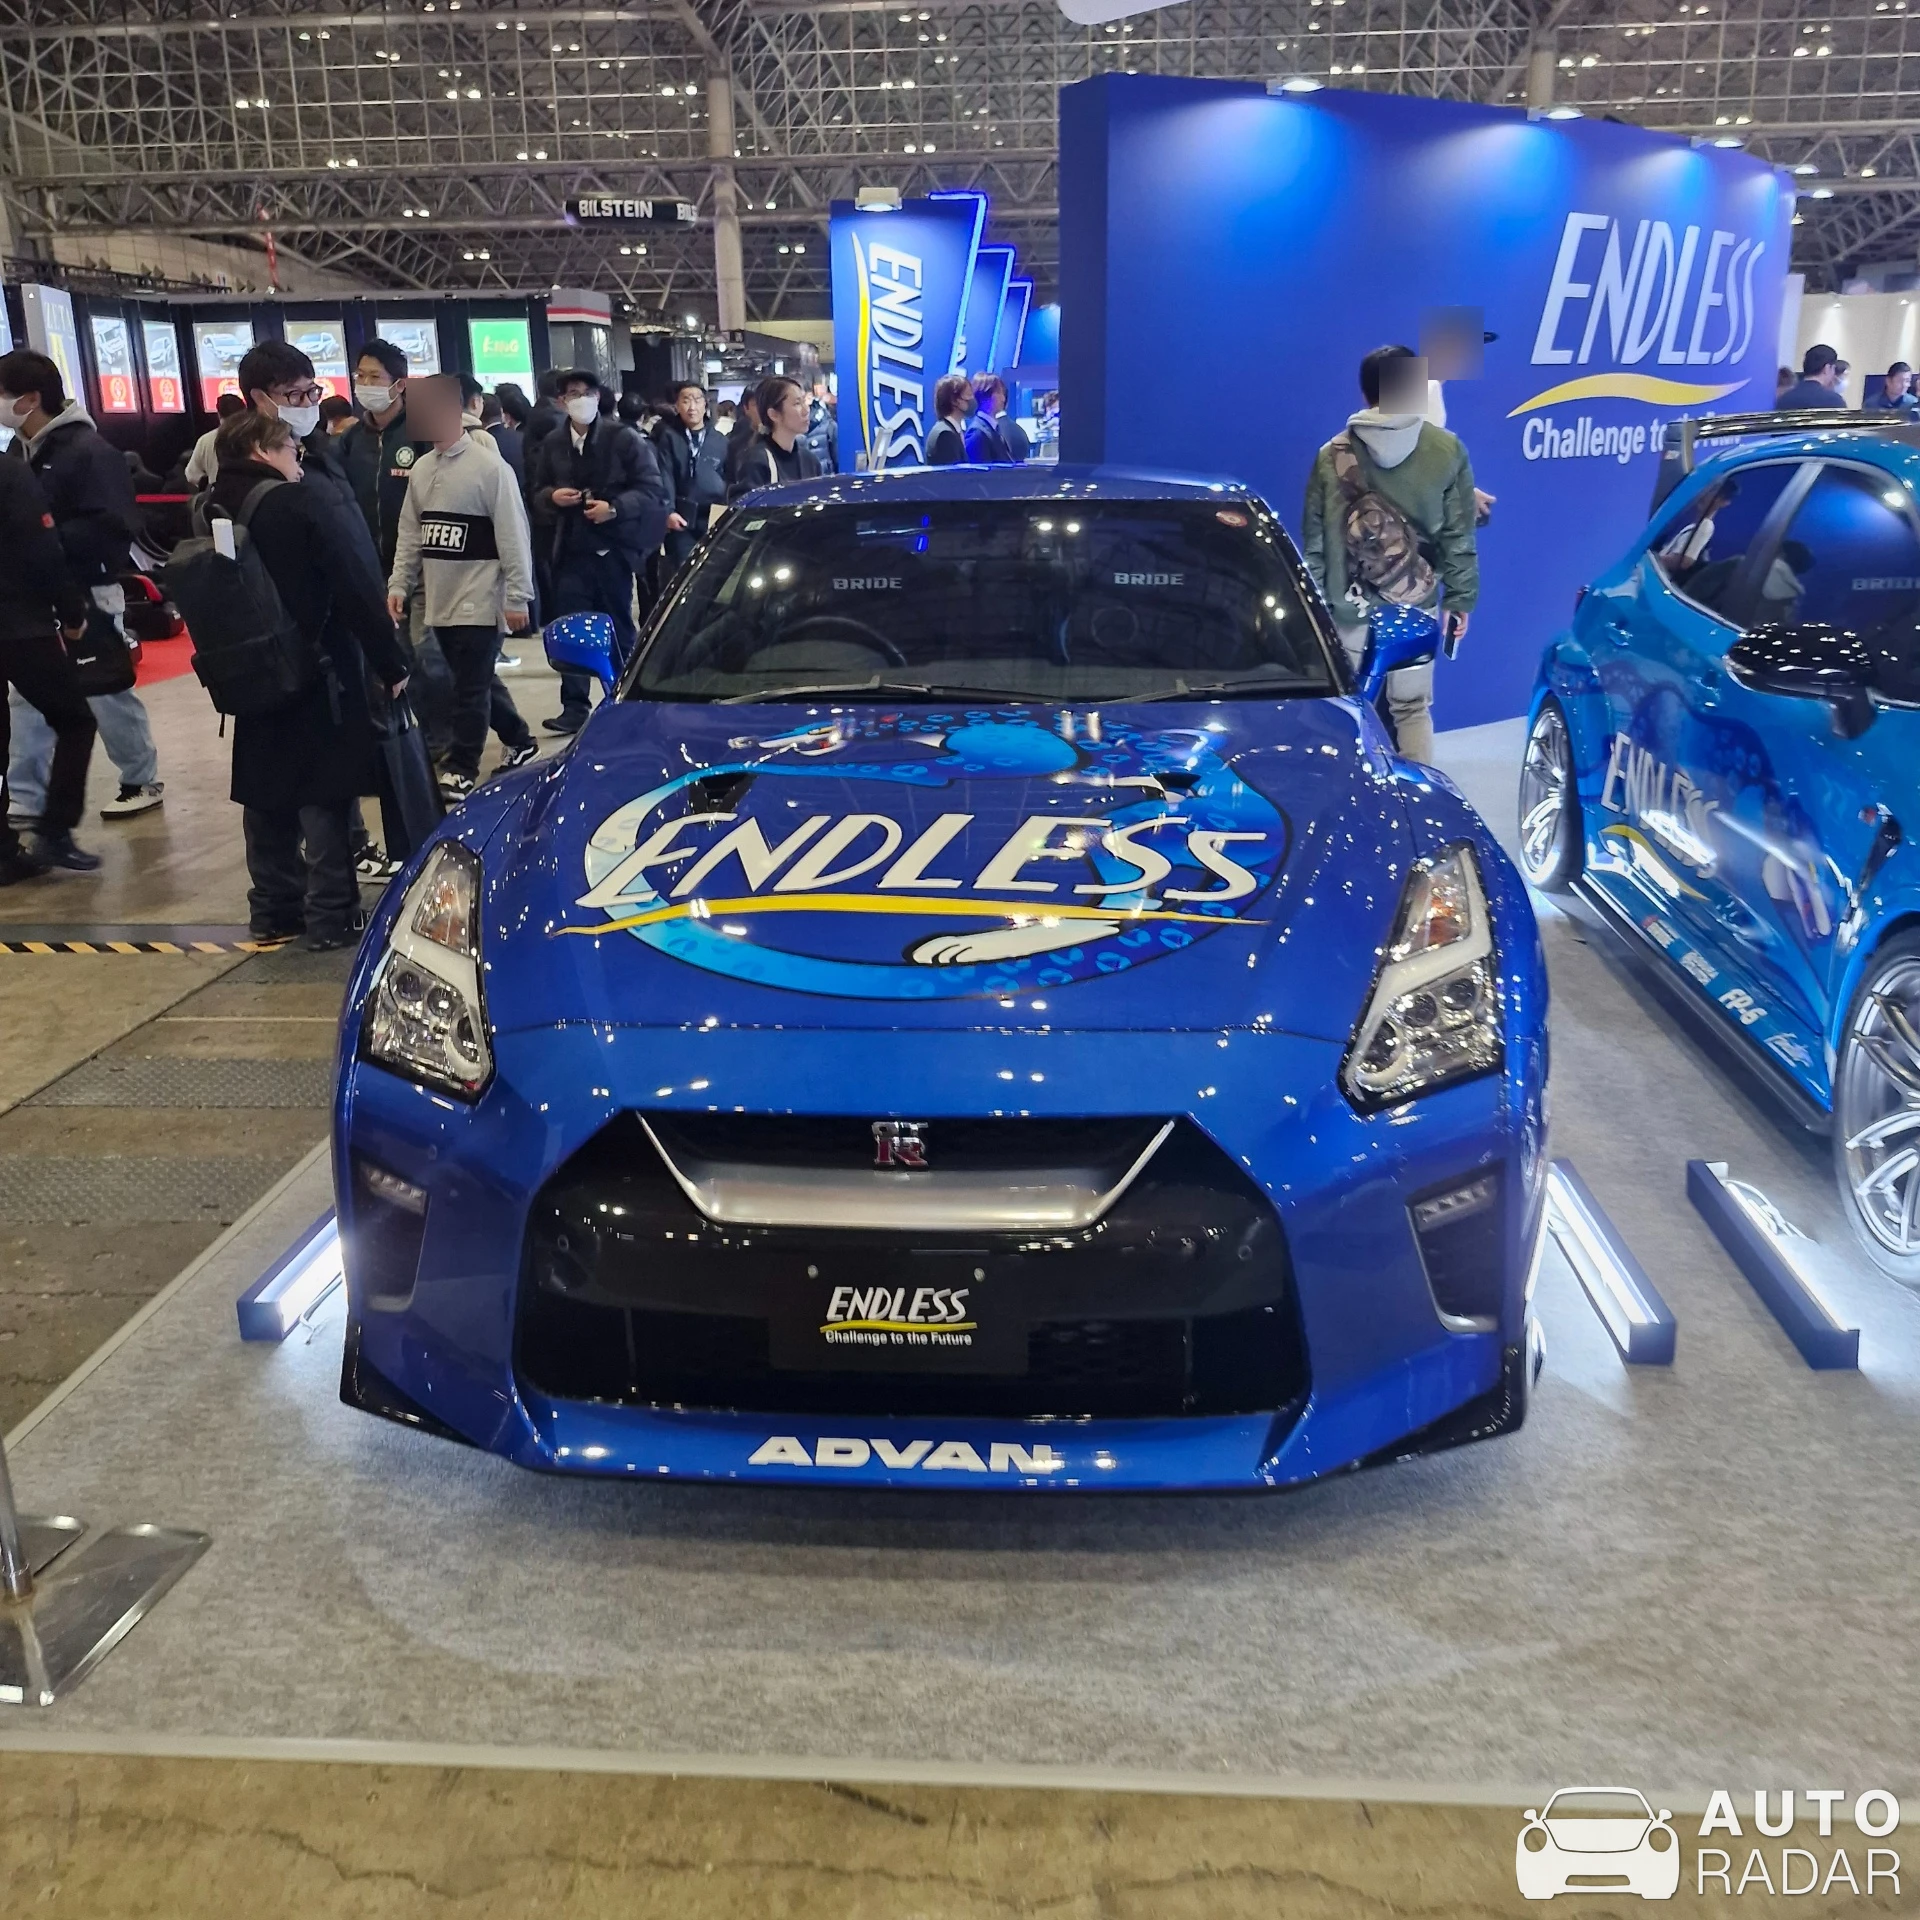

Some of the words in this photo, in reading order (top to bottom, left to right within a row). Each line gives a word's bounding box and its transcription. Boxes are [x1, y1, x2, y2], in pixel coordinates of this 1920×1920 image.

[578, 200, 653, 218] BILSTEIN
[1530, 211, 1765, 365] ENDLESS
[869, 242, 924, 464] ENDLESS
[1523, 415, 1645, 464] Challenge
[833, 577, 902, 590] BRIDE
[1113, 572, 1184, 586] BRIDE
[575, 812, 1268, 908] ENDLESS
[1718, 988, 1768, 1026] FP-6
[826, 1286, 970, 1323] ENDLESS
[825, 1330, 888, 1346] Challenge
[890, 1331, 904, 1345] to
[906, 1331, 928, 1345] the
[931, 1332, 972, 1346] Future
[748, 1436, 1052, 1474] ADVAN
